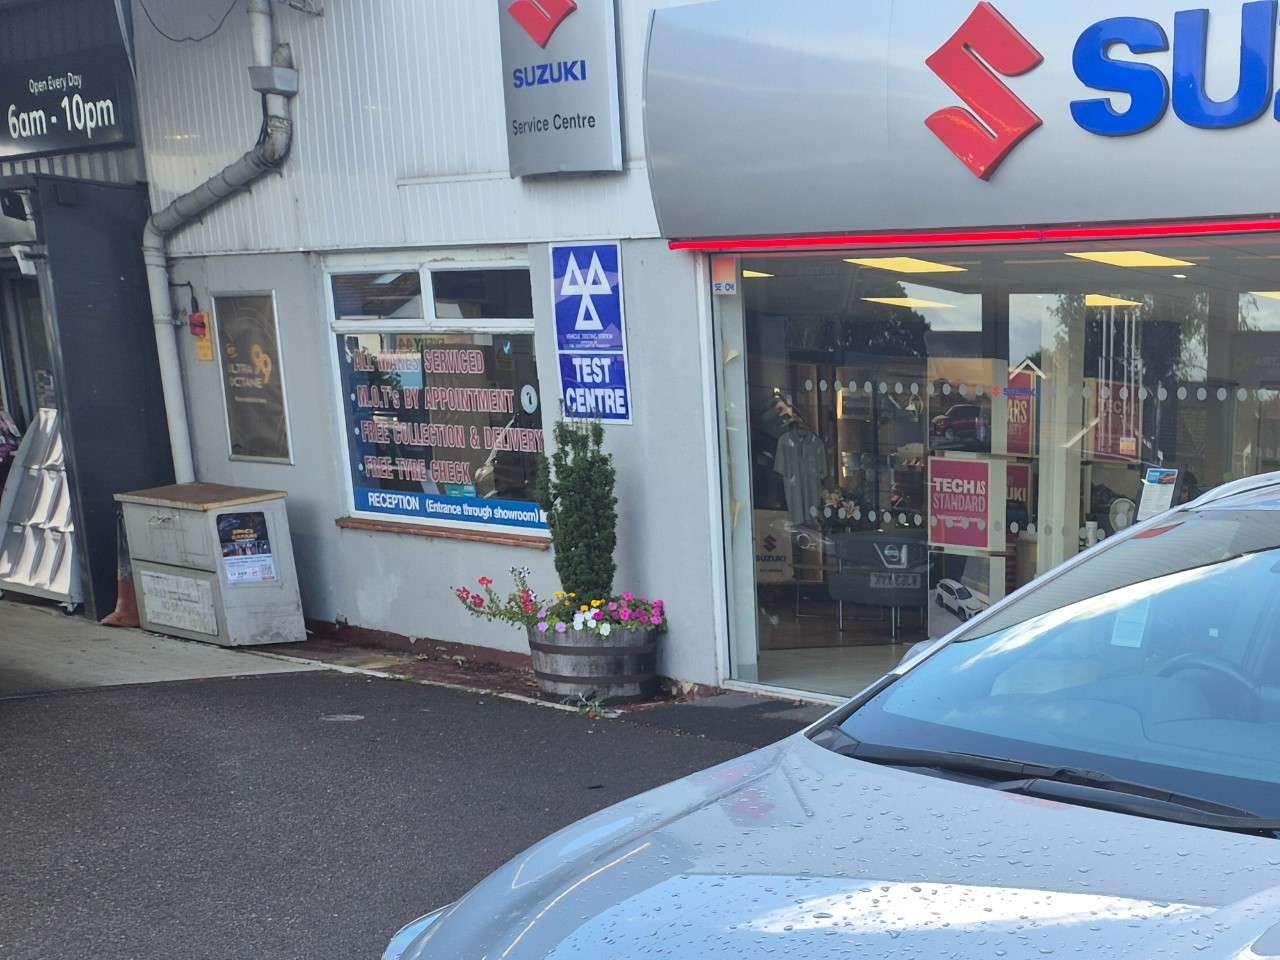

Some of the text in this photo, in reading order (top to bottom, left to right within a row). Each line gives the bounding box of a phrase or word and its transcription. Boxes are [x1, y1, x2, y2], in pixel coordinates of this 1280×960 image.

[29, 72, 82, 95] Open Every Day
[512, 60, 587, 89] SUZUKI
[8, 104, 47, 138] 6am
[61, 93, 115, 139] 10pm
[512, 113, 596, 136] Service Centre
[353, 349, 375, 372] ALL
[423, 350, 485, 374] SERVICED
[571, 357, 611, 383] TEST
[403, 386, 420, 410] BY
[424, 386, 515, 413] APPOINTMENT
[565, 387, 626, 414] CENTRE
[360, 420, 544, 453] FREE COLLECTION & DELIVERY
[364, 455, 472, 485] FREE TYRE CHECK
[932, 477, 986, 495] TECH AS
[368, 492, 539, 523] RECEPTION (Entrance through showroom)
[932, 493, 986, 513] STANDARD
